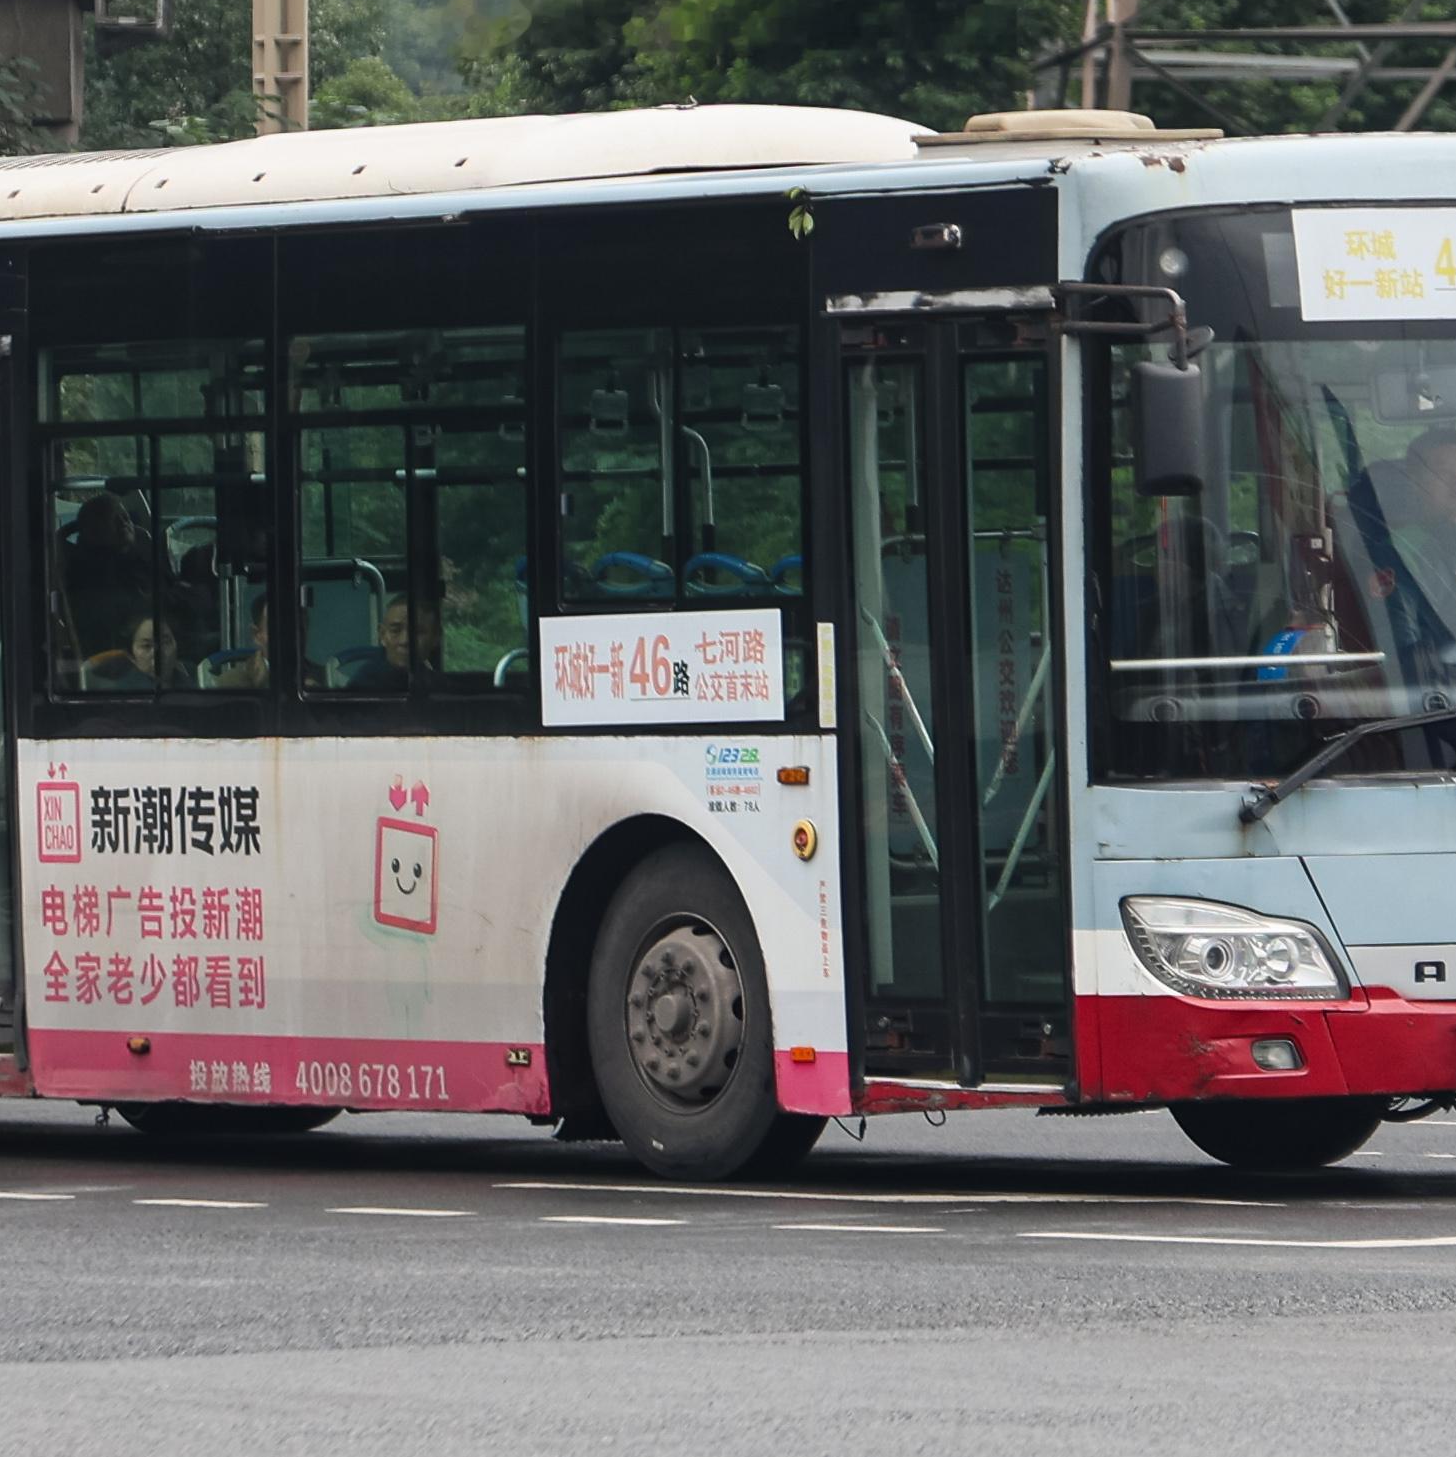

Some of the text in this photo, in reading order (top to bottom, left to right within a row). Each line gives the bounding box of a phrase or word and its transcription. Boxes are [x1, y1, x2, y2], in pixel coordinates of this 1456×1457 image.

[1345, 230, 1397, 261] 环城
[629, 634, 690, 697] 46路
[694, 629, 766, 666] 七河路
[694, 669, 769, 703] 公交首末站
[44, 795, 63, 823] XIN
[90, 785, 261, 857] 新潮传媒
[45, 824, 75, 852] CHAO
[41, 883, 265, 942] 电梯广告投新潮
[43, 950, 267, 1010] 全家老少都看到
[189, 1059, 449, 1100] 投放热线 4008 678 171
